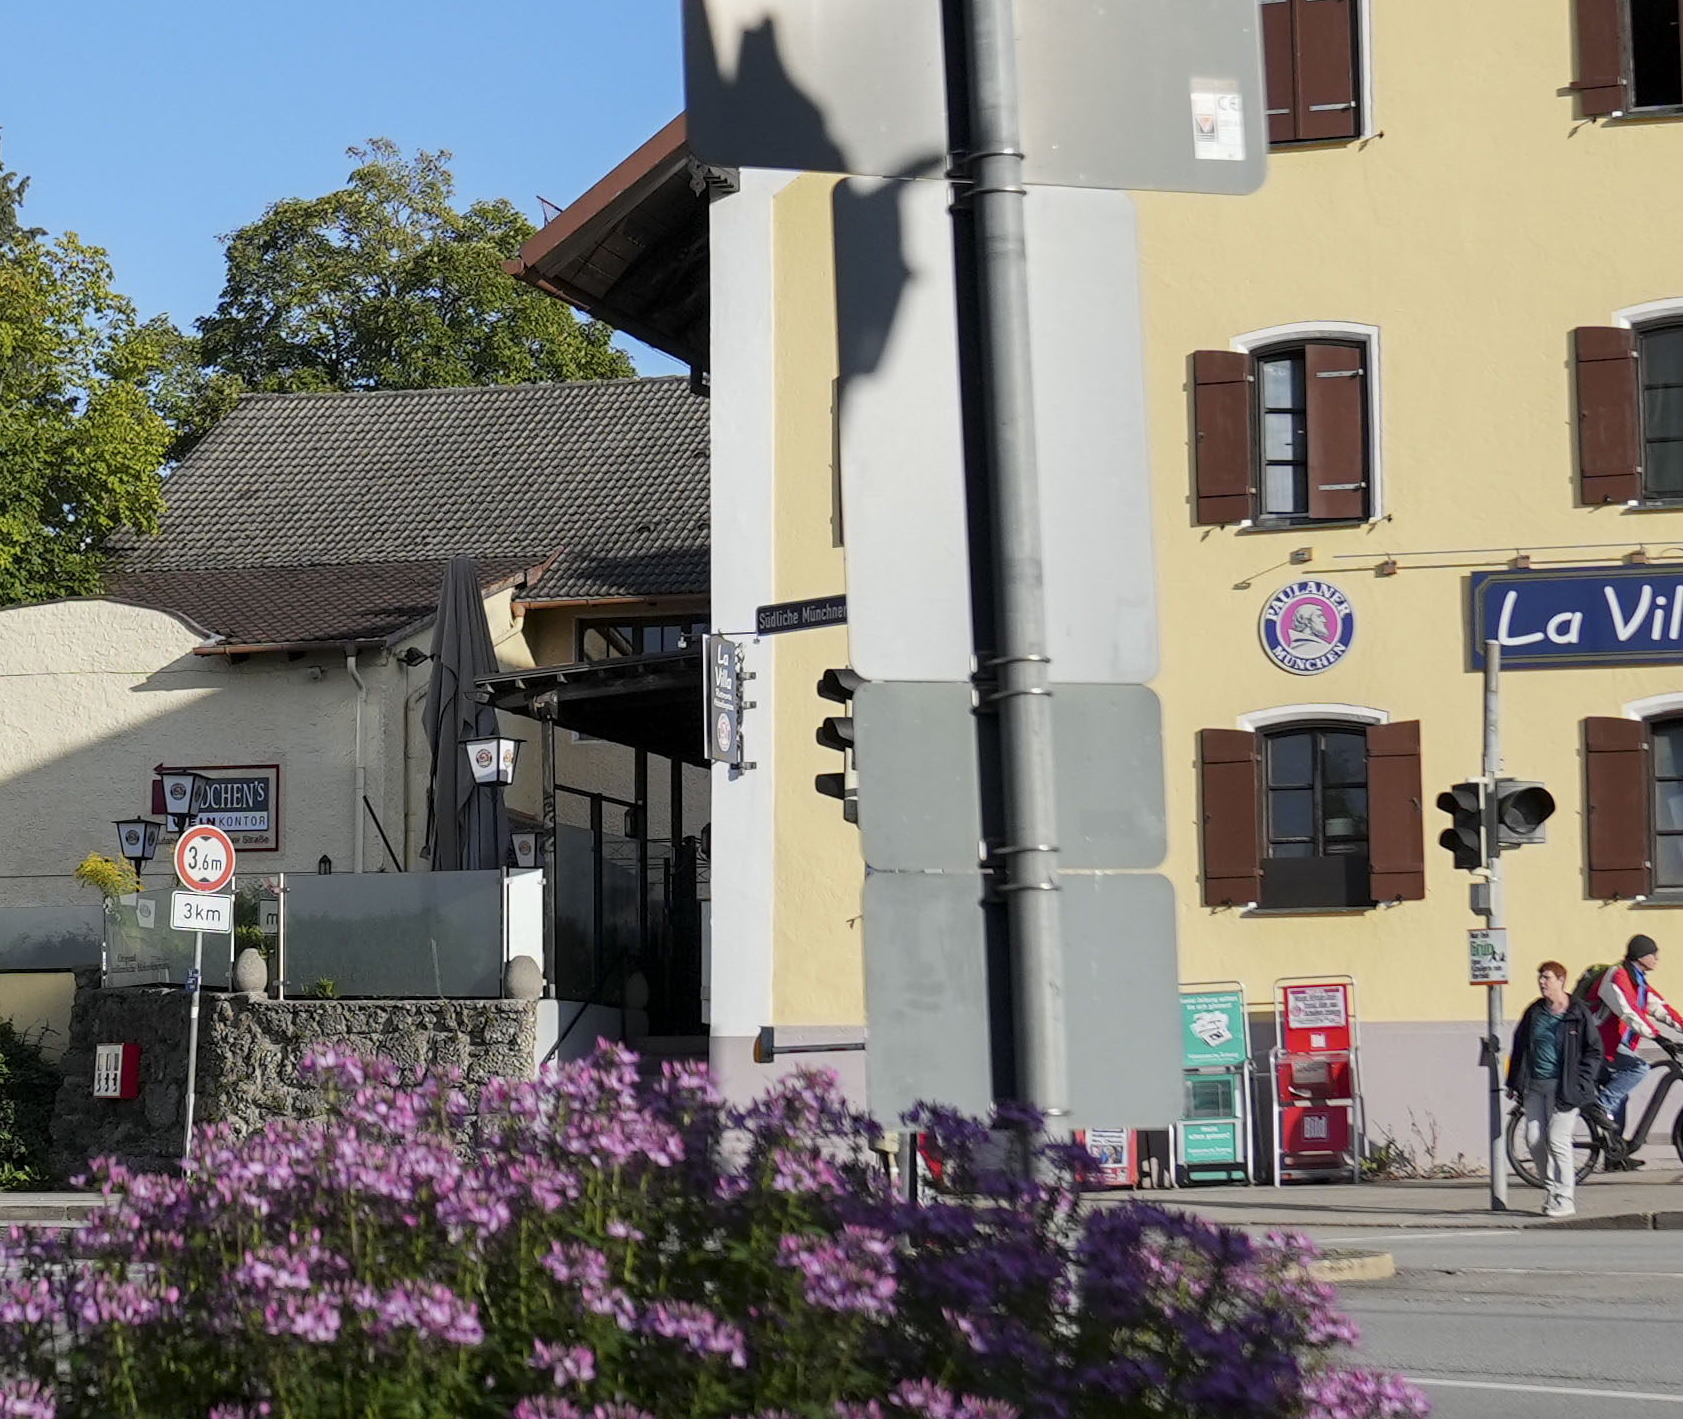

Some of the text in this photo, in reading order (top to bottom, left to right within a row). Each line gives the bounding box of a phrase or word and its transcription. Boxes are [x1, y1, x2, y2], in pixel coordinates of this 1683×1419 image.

[1265, 581, 1352, 621] PAULANER
[759, 610, 799, 630] Südliche
[1496, 589, 1584, 647] La
[242, 835, 271, 845] Straße
